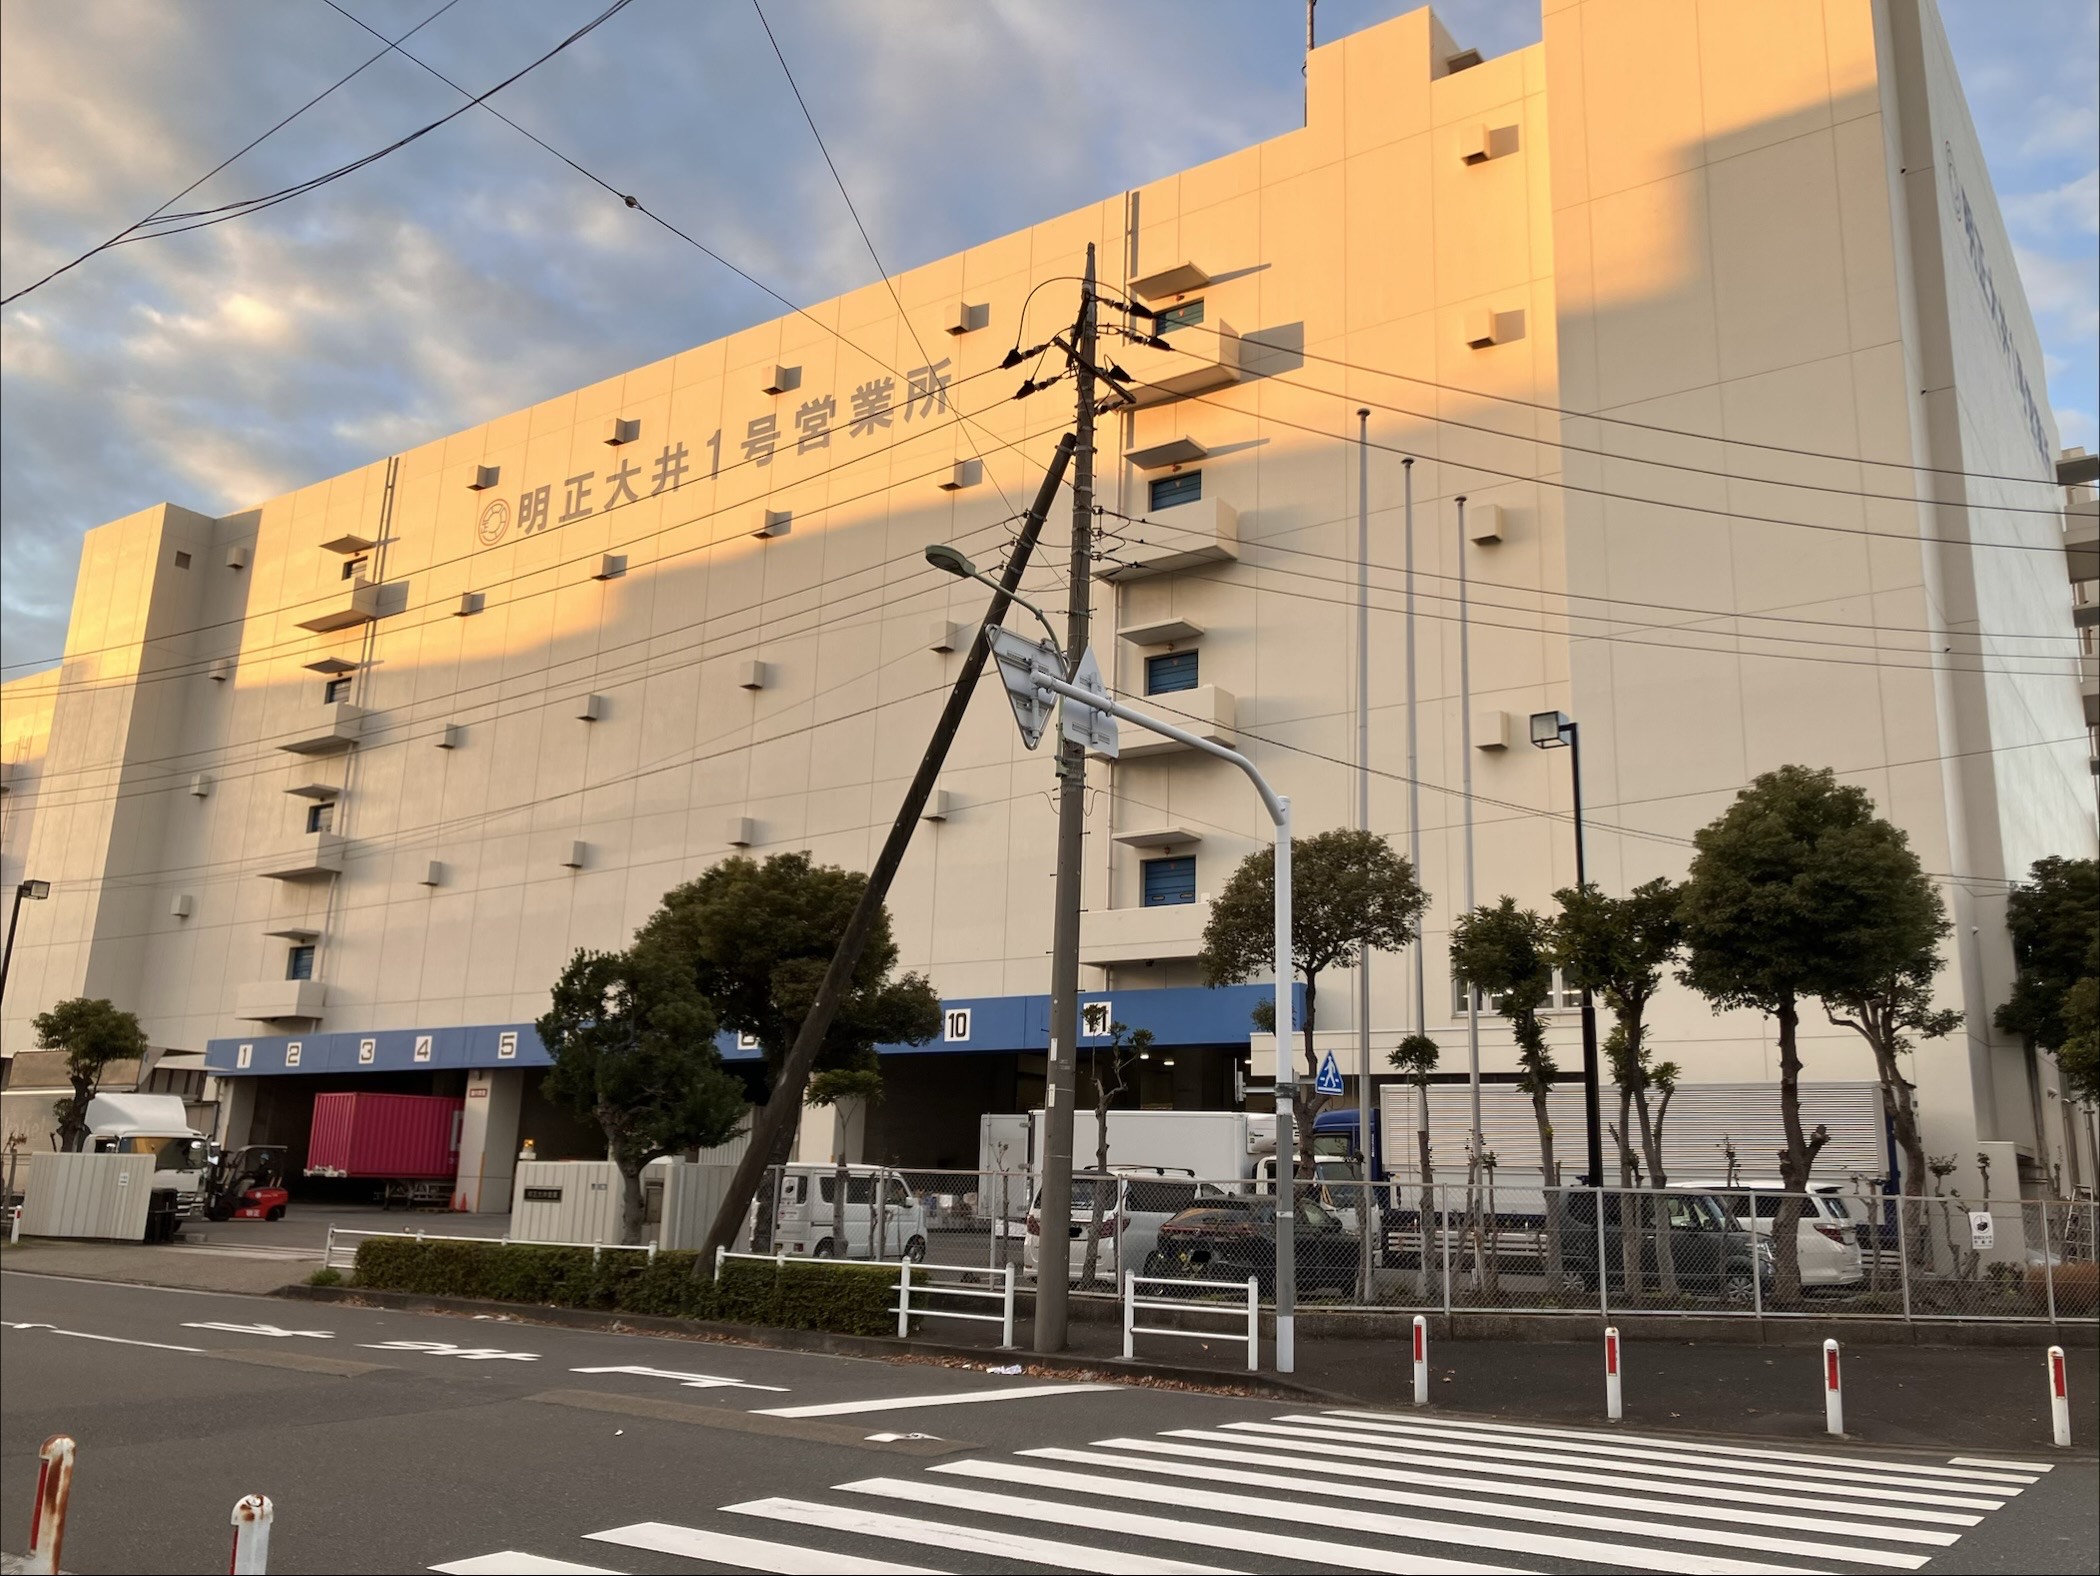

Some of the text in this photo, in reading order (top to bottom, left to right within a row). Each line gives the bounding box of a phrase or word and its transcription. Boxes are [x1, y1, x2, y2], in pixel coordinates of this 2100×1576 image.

[517, 357, 952, 535] 明正大井1号営業所
[948, 1012, 967, 1038] 10
[241, 1046, 248, 1066] 1
[287, 1045, 300, 1064] 2
[360, 1041, 374, 1061] 3
[416, 1038, 429, 1059] 4
[501, 1035, 516, 1056] 5
